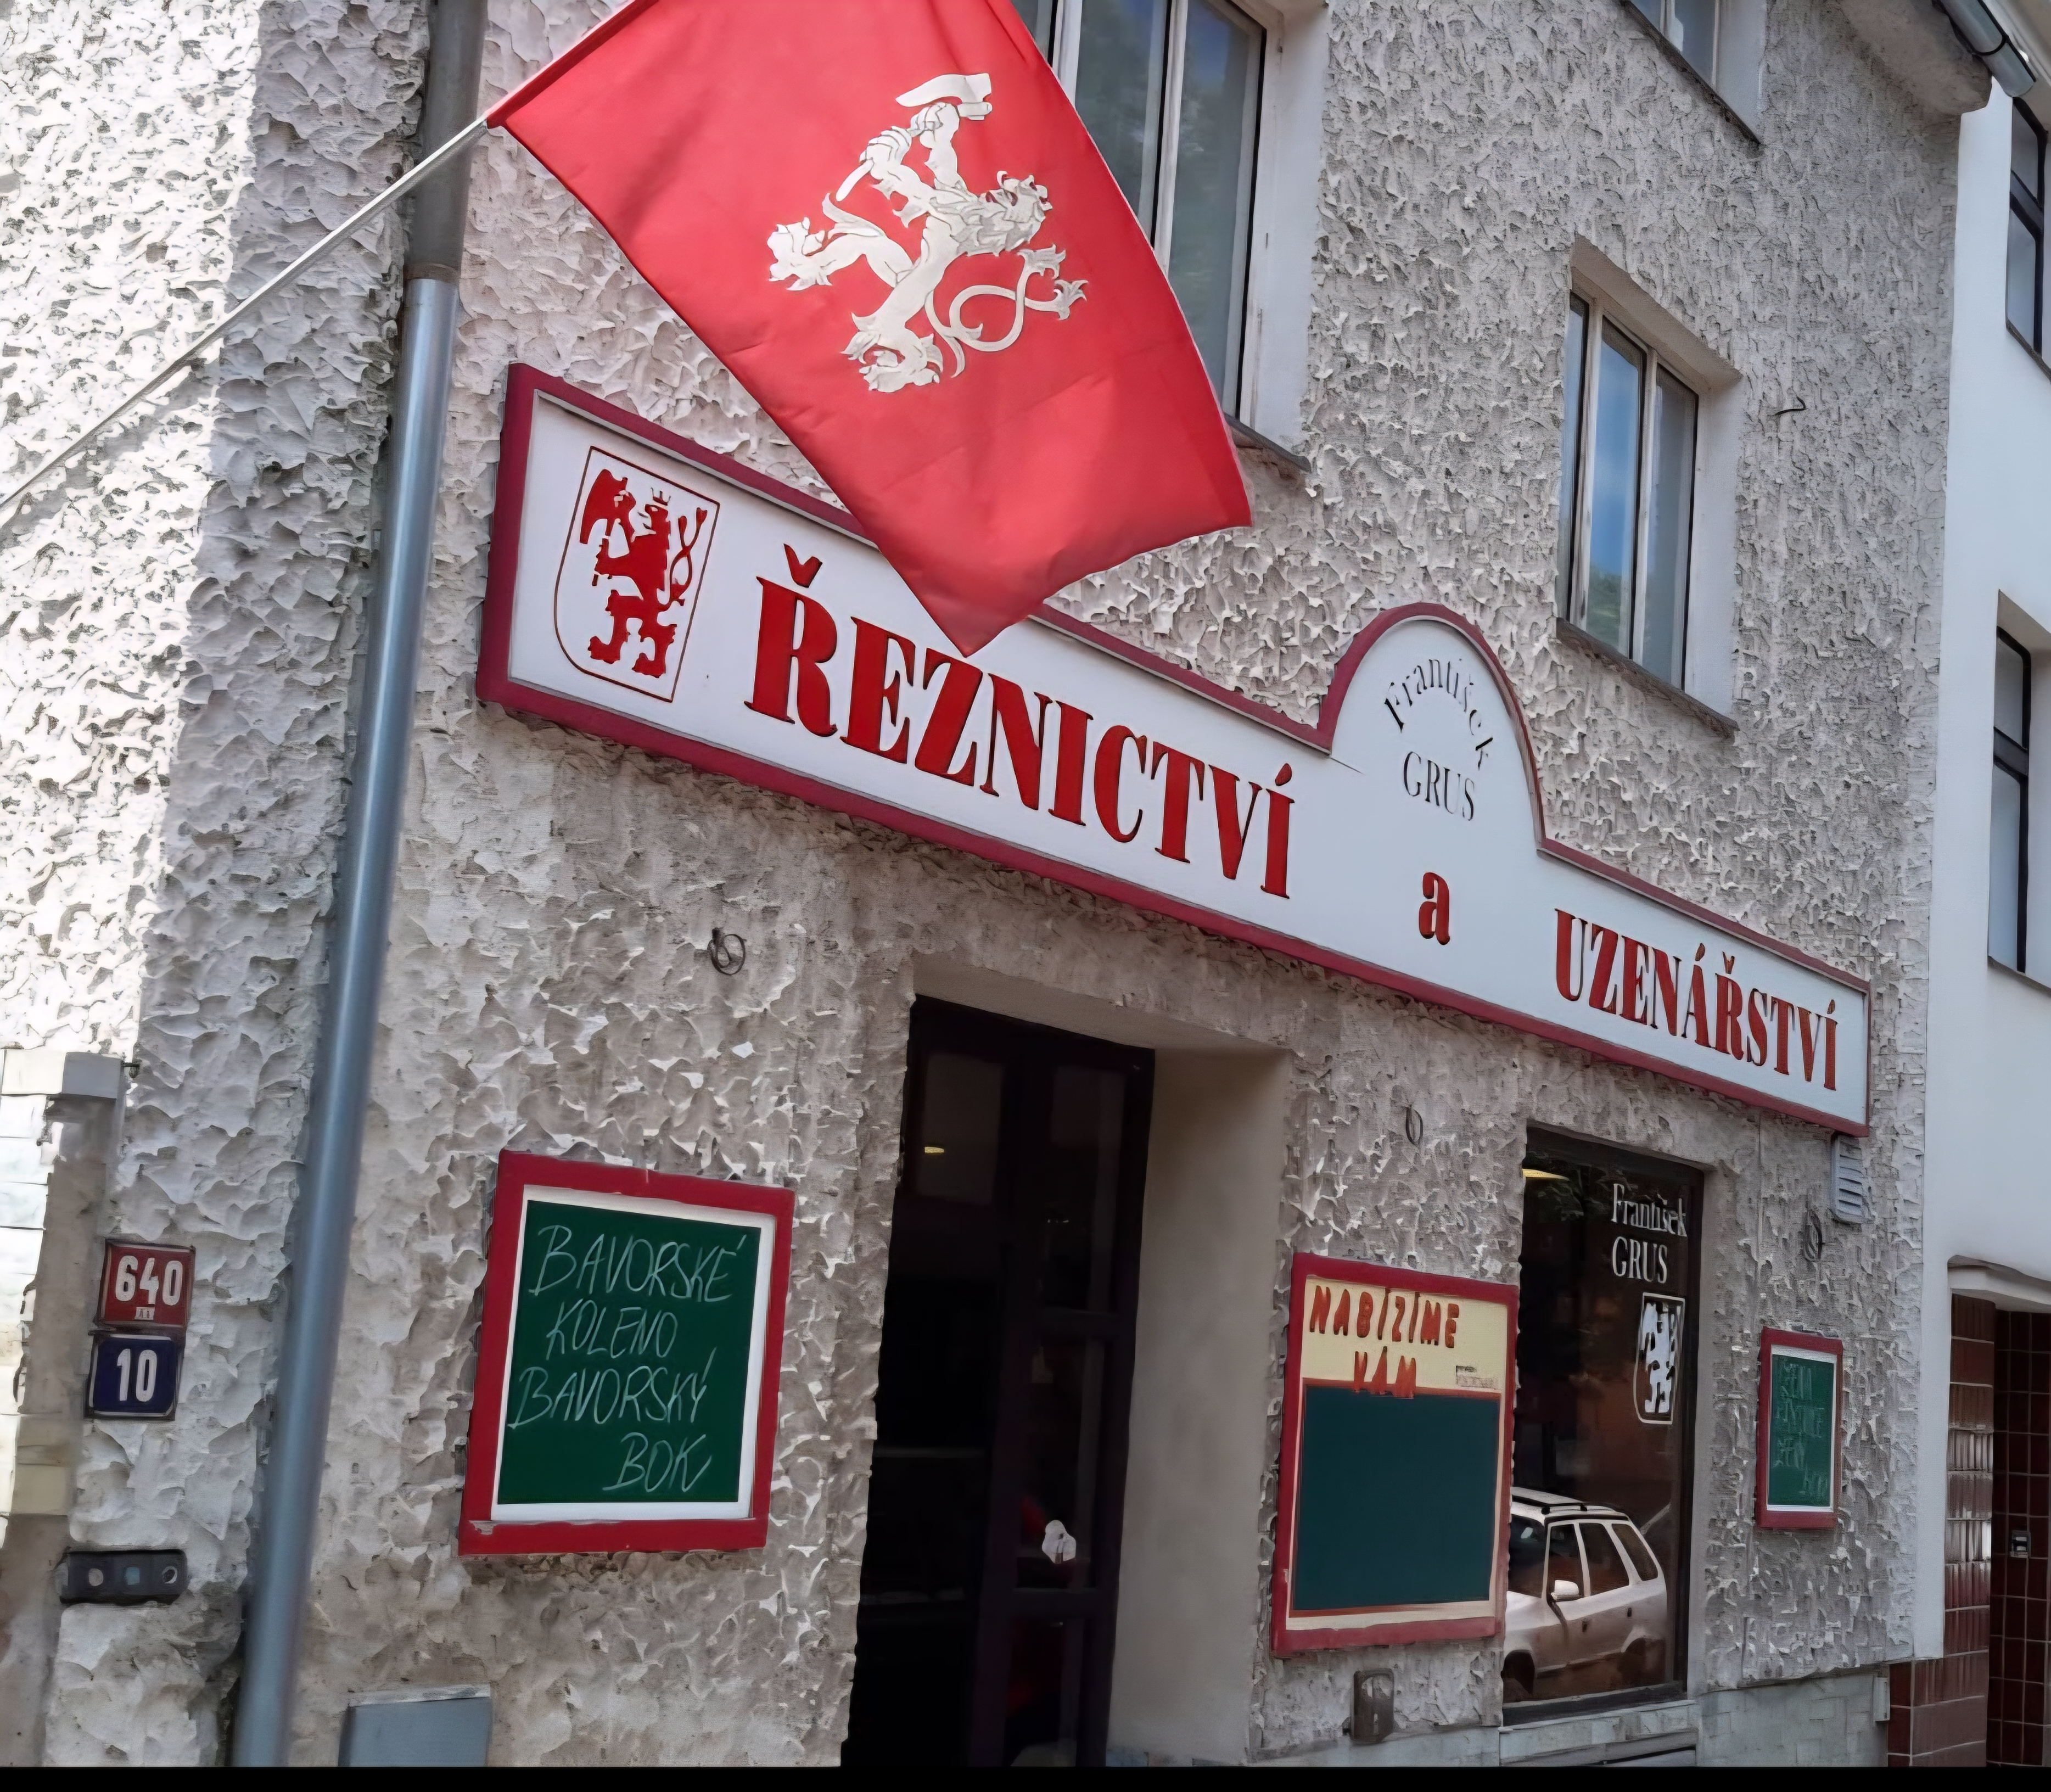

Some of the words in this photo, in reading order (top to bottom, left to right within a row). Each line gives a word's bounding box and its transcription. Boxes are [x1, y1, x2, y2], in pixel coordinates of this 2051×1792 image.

[1403, 751, 1475, 821] GRUS
[743, 544, 1295, 899] ŘEZNICTVÍ
[1419, 872, 1450, 945] a
[1554, 908, 1838, 1091] UZENÁŘSTVÍ
[115, 1255, 183, 1306] 640
[528, 1224, 747, 1303] BAVORSKÉ
[1612, 1236, 1668, 1284] GRUS
[546, 1298, 679, 1360] KOLENO
[117, 1348, 158, 1402] 10
[506, 1346, 718, 1430] BAVORSKÝ
[602, 1432, 713, 1493] BOK
